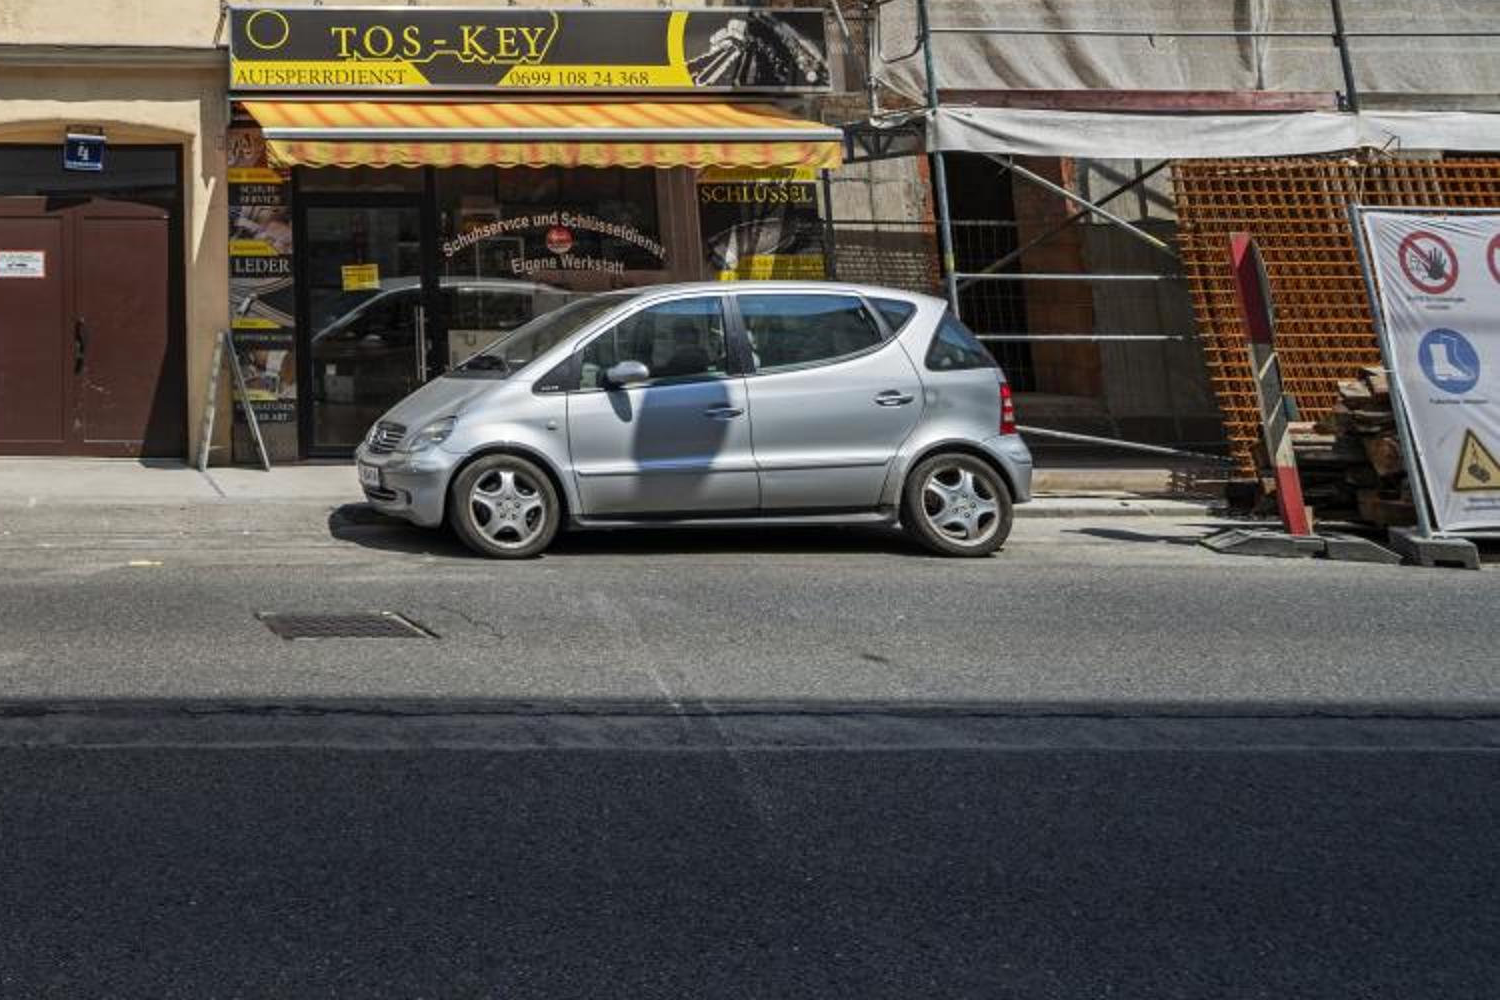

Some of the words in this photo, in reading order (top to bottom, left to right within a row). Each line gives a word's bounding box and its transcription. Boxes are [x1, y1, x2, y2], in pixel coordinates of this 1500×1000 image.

[236, 67, 408, 86] AUFSPERRDIENST
[509, 70, 551, 87] 0699
[556, 70, 588, 87] 108
[593, 70, 613, 87] 24
[619, 70, 649, 87] 368
[700, 183, 814, 203] SCHLÜSSEL
[442, 215, 529, 258] Schuhservice
[533, 211, 559, 227] und
[560, 212, 667, 260] Schlüsseldienst
[234, 258, 291, 274] LEDER
[511, 254, 558, 276] Eigene
[560, 253, 625, 277] Werkstatt
